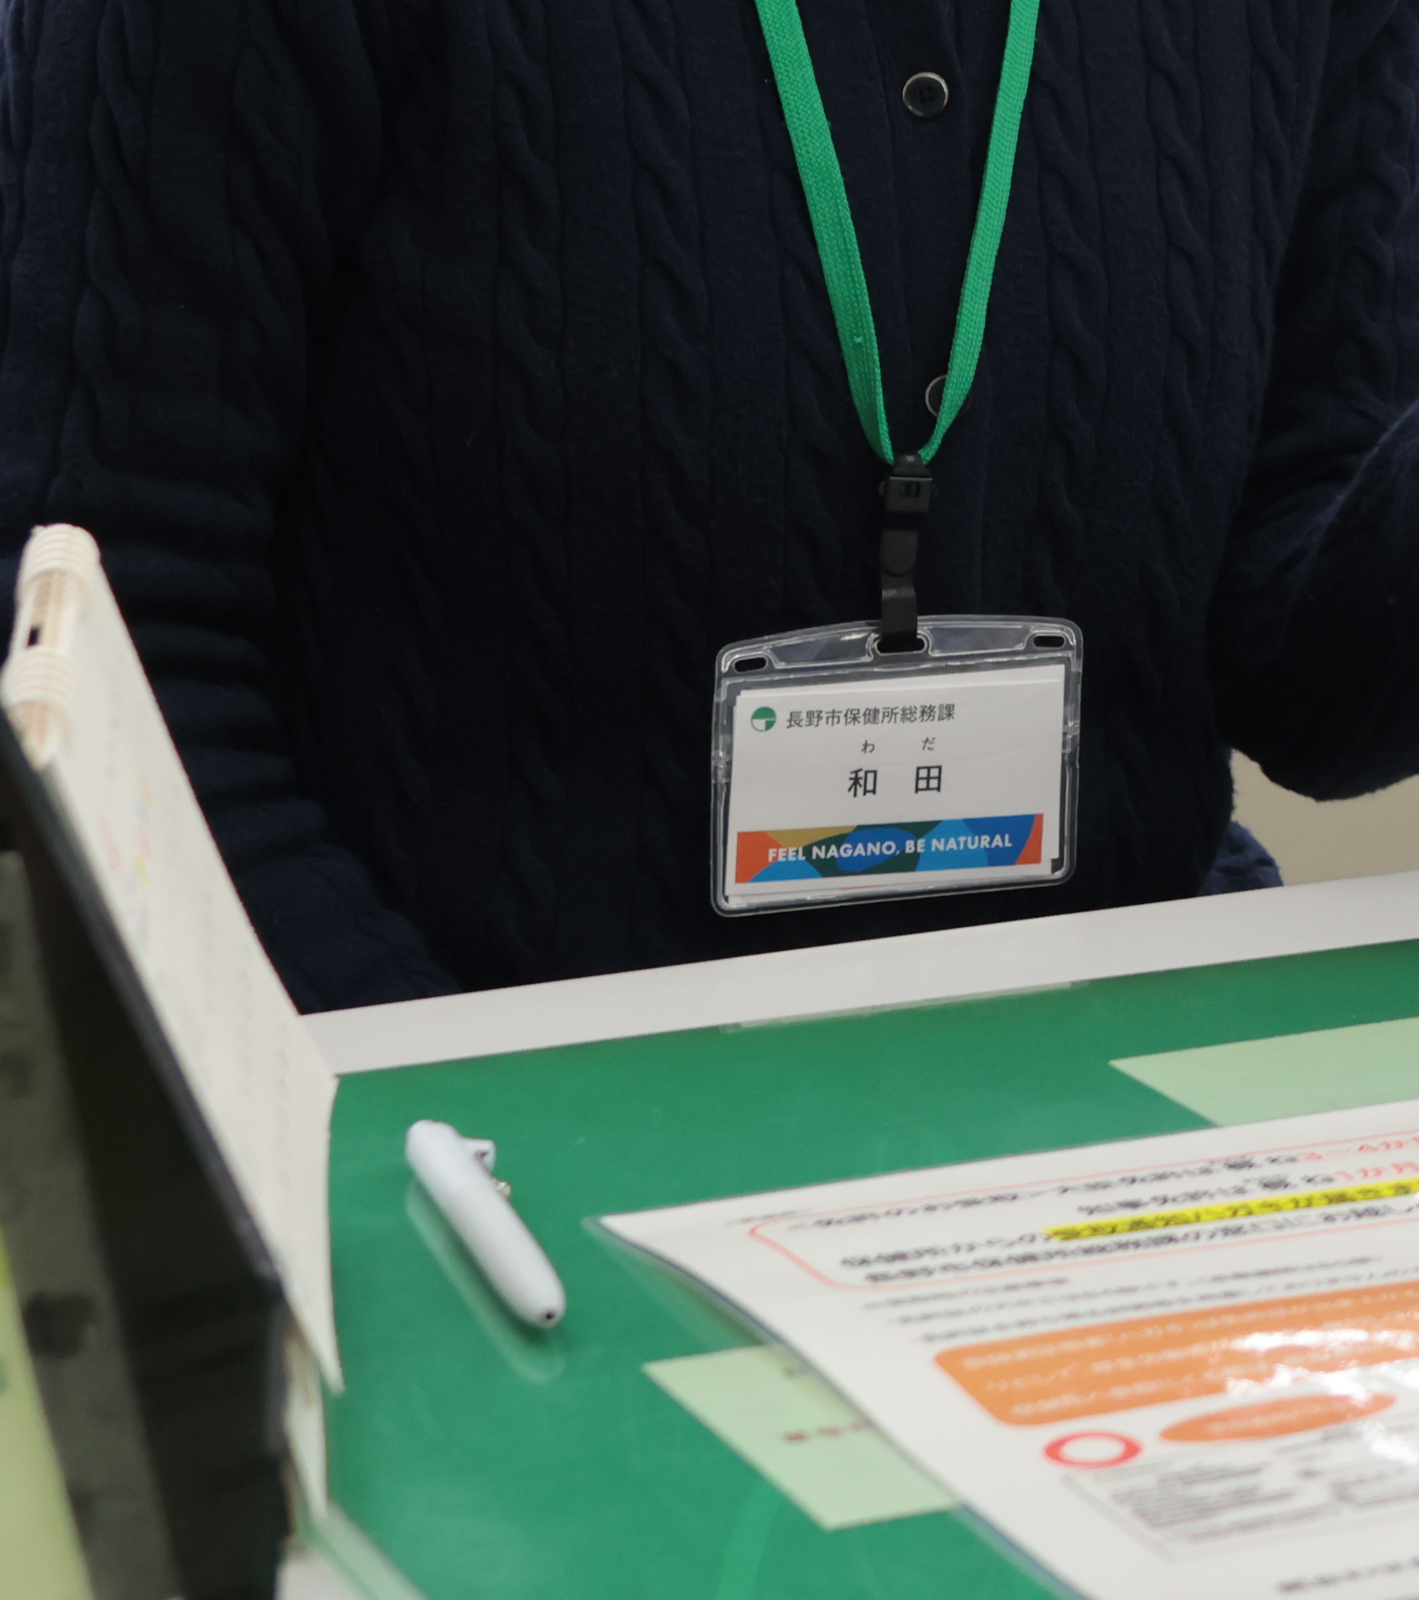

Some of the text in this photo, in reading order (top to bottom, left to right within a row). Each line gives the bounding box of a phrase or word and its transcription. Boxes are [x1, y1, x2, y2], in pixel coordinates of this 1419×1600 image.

[786, 704, 956, 730] 長野市保健所総務課
[768, 834, 1013, 862] FEEL NAGANO, BE NATURAL
